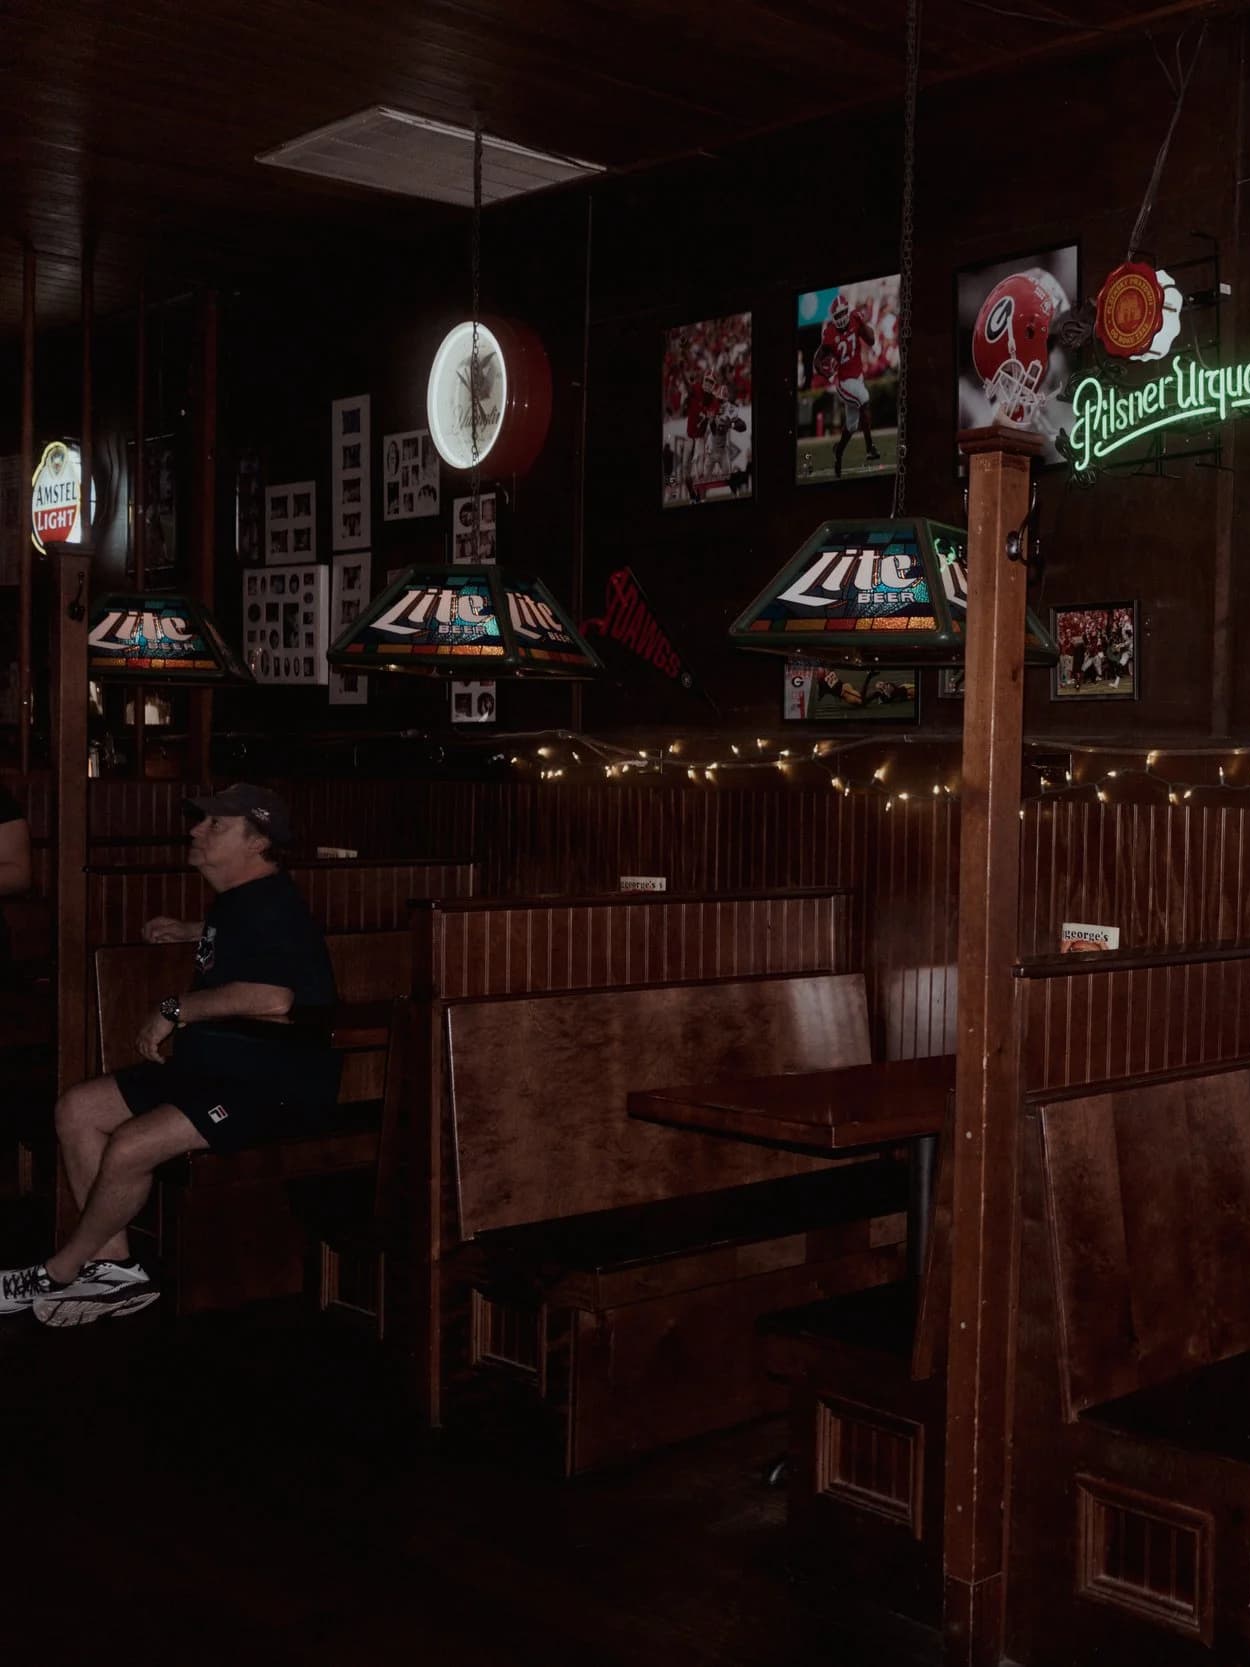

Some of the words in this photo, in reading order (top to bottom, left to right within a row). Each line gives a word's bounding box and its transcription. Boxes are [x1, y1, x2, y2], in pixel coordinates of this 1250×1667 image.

[1069, 376, 1174, 472] Pilsner
[36, 481, 78, 507] AMSTEL
[37, 508, 76, 532] LIGHT
[776, 548, 918, 607] Lite
[857, 592, 915, 604] BEER
[368, 588, 496, 636] Lite
[88, 610, 193, 650] Lite
[438, 625, 488, 635] BEER
[1064, 929, 1110, 942] george's
